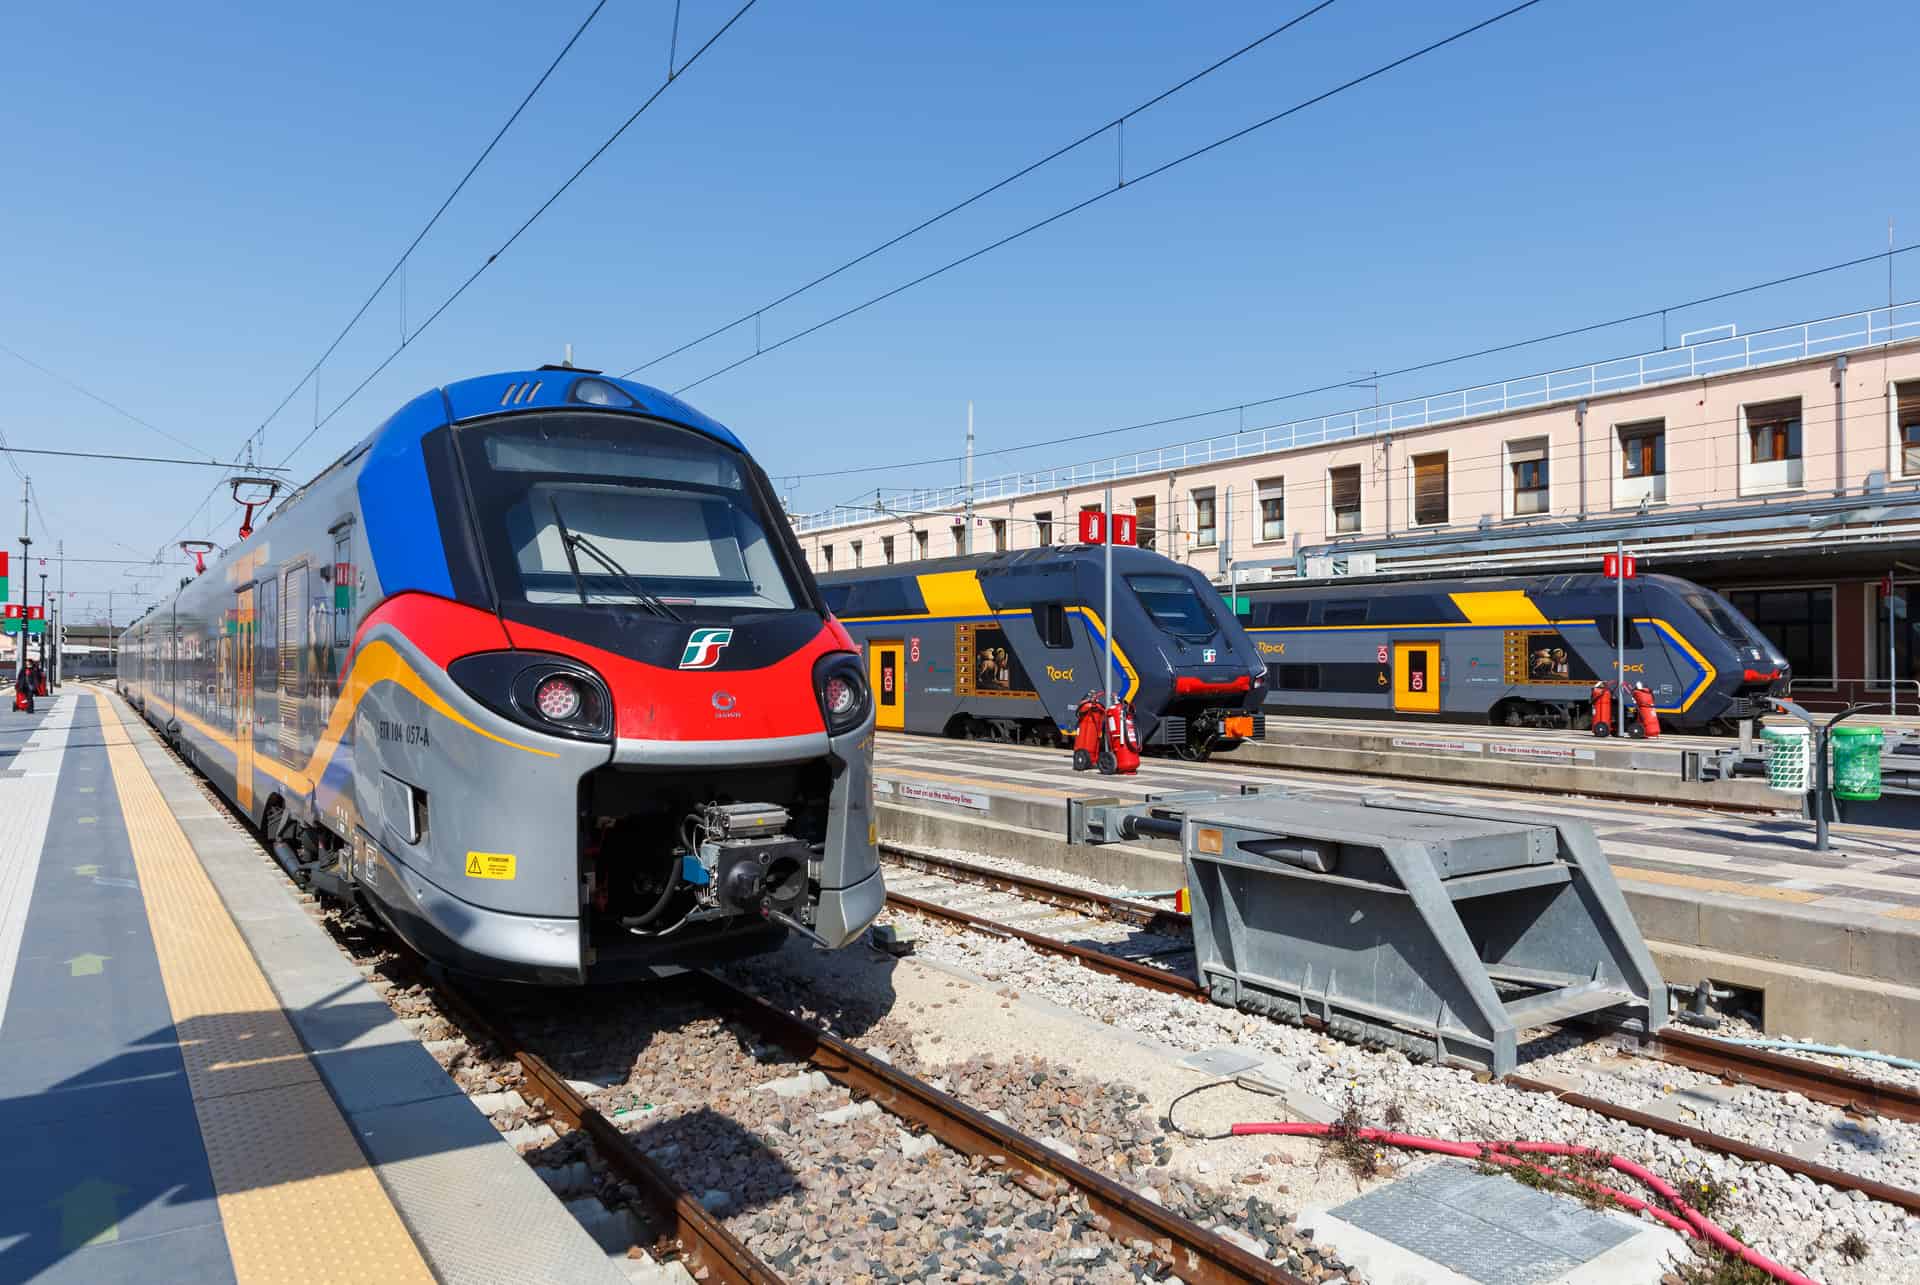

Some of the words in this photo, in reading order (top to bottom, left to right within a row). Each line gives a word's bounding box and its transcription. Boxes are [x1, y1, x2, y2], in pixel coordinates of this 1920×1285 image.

[379, 720, 389, 740] ETR
[391, 722, 402, 743] 104
[406, 724, 430, 747] 057-A
[942, 791, 961, 804] railway
